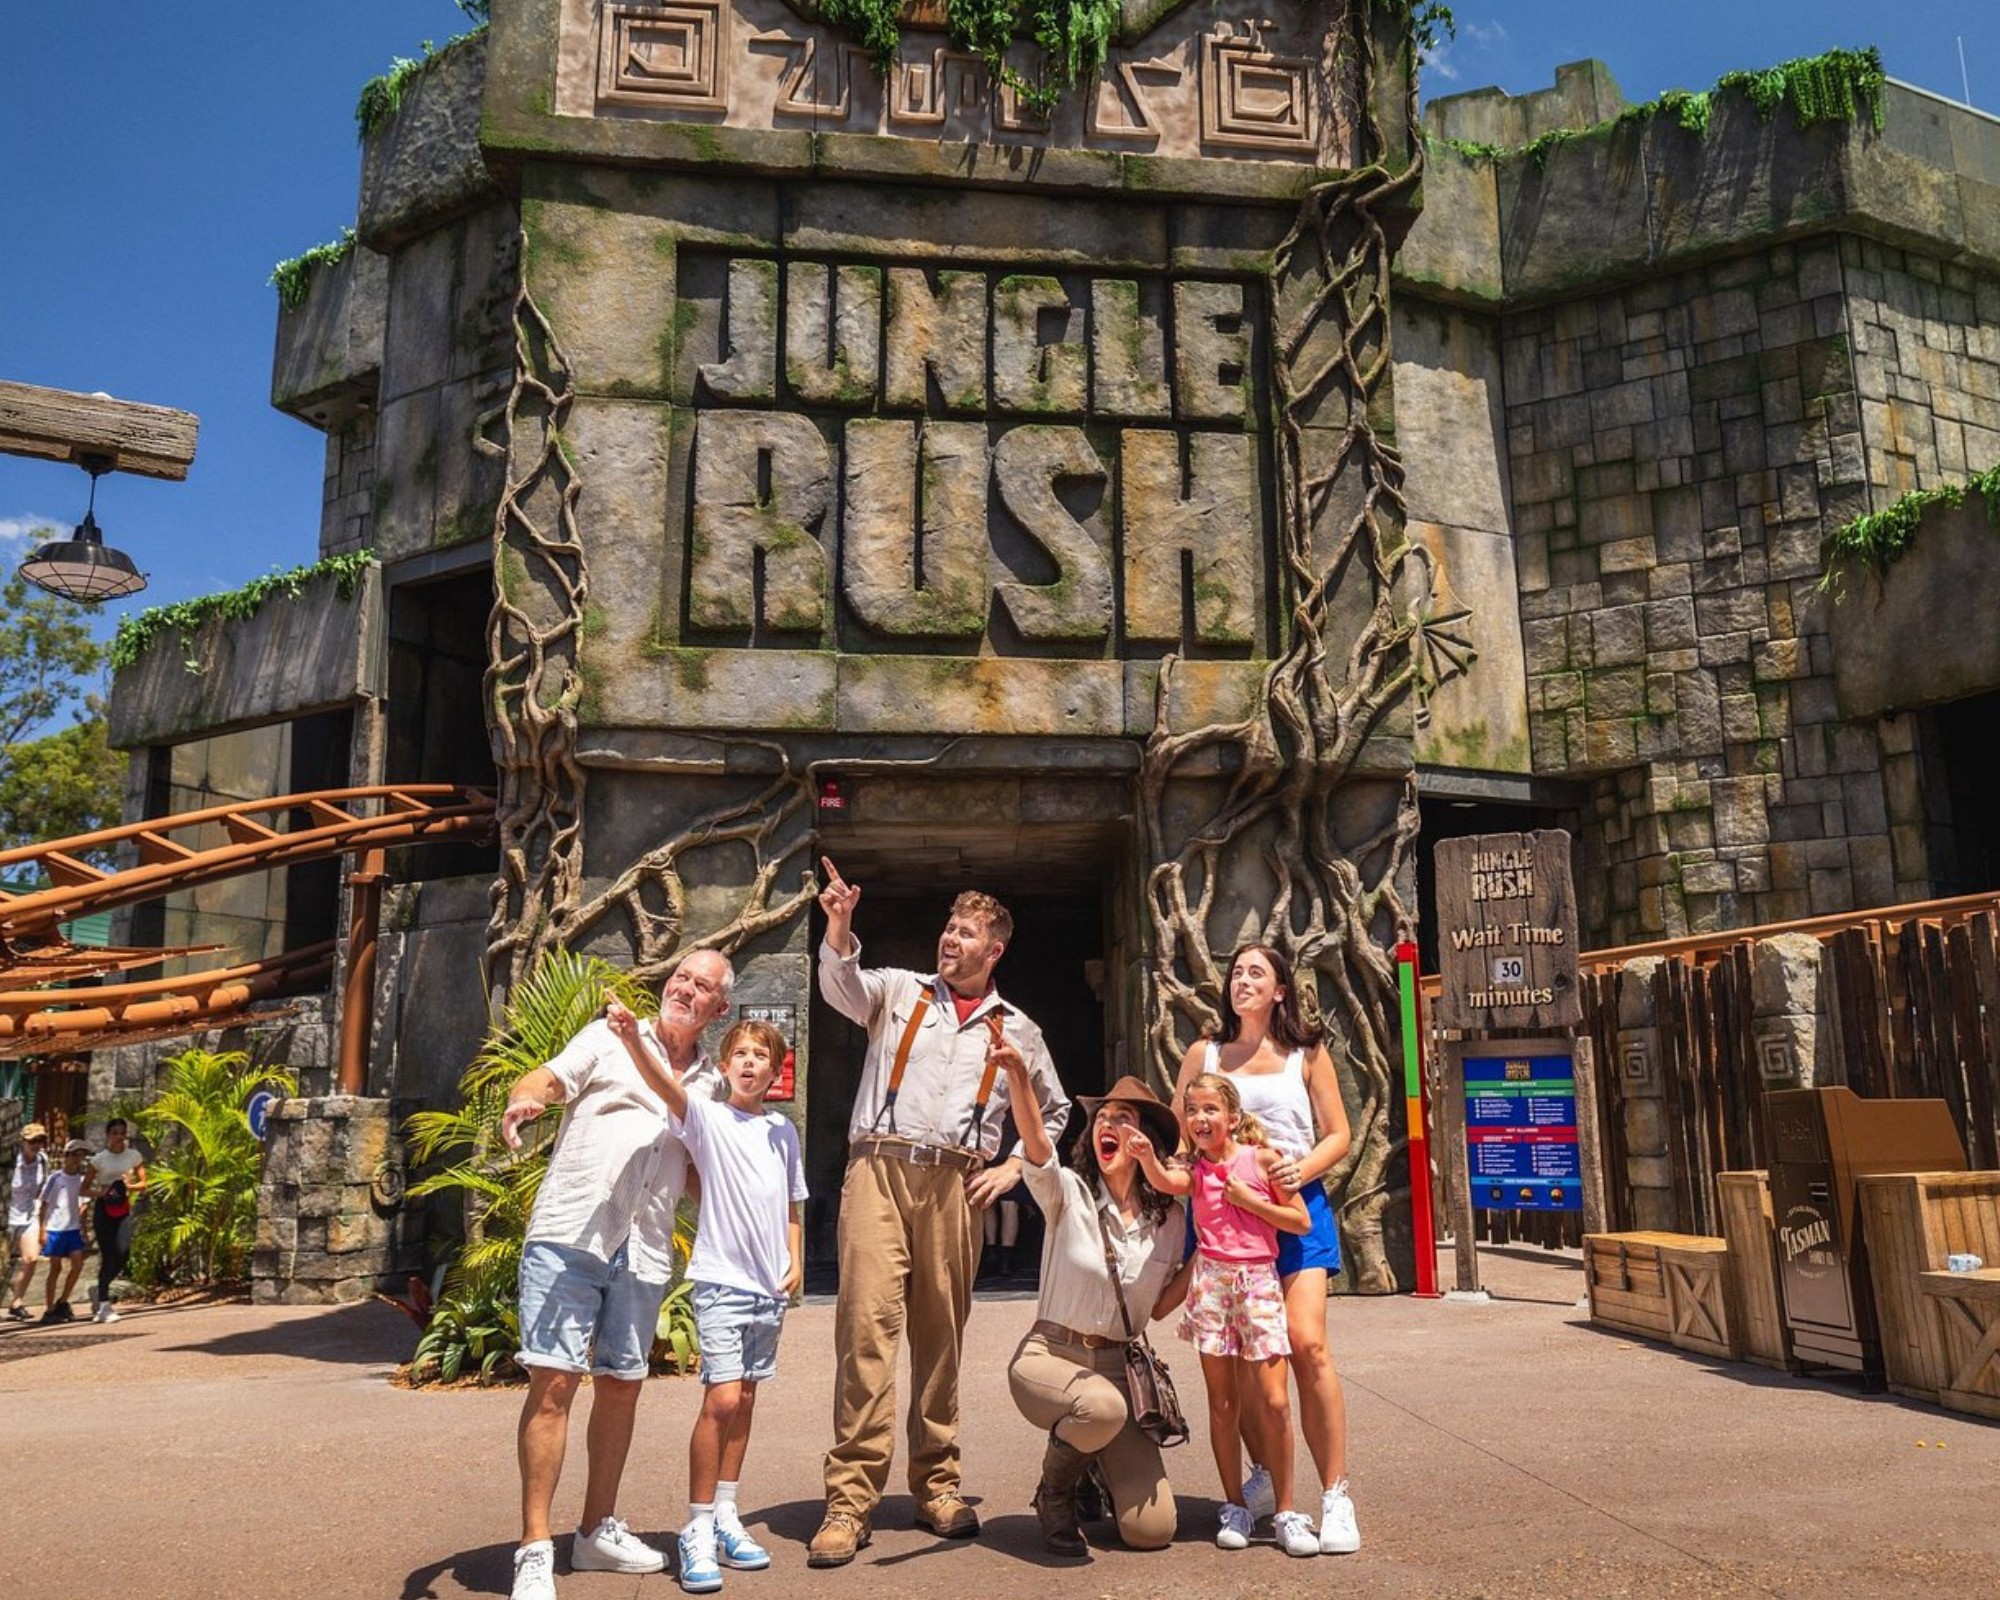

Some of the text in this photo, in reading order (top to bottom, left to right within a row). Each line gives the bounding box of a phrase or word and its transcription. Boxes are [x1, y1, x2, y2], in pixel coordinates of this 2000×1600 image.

[698, 257, 1246, 418] JUNGLE
[689, 408, 1256, 645] RUSH
[1471, 849, 1534, 873] JUNGLE
[1471, 868, 1534, 901] RUSH
[1451, 921, 1564, 950] Wait Time
[1501, 961, 1521, 978] 30
[1468, 985, 1554, 1008] minutes
[770, 1009, 788, 1022] THE
[1780, 1219, 1831, 1262] TASMAN
